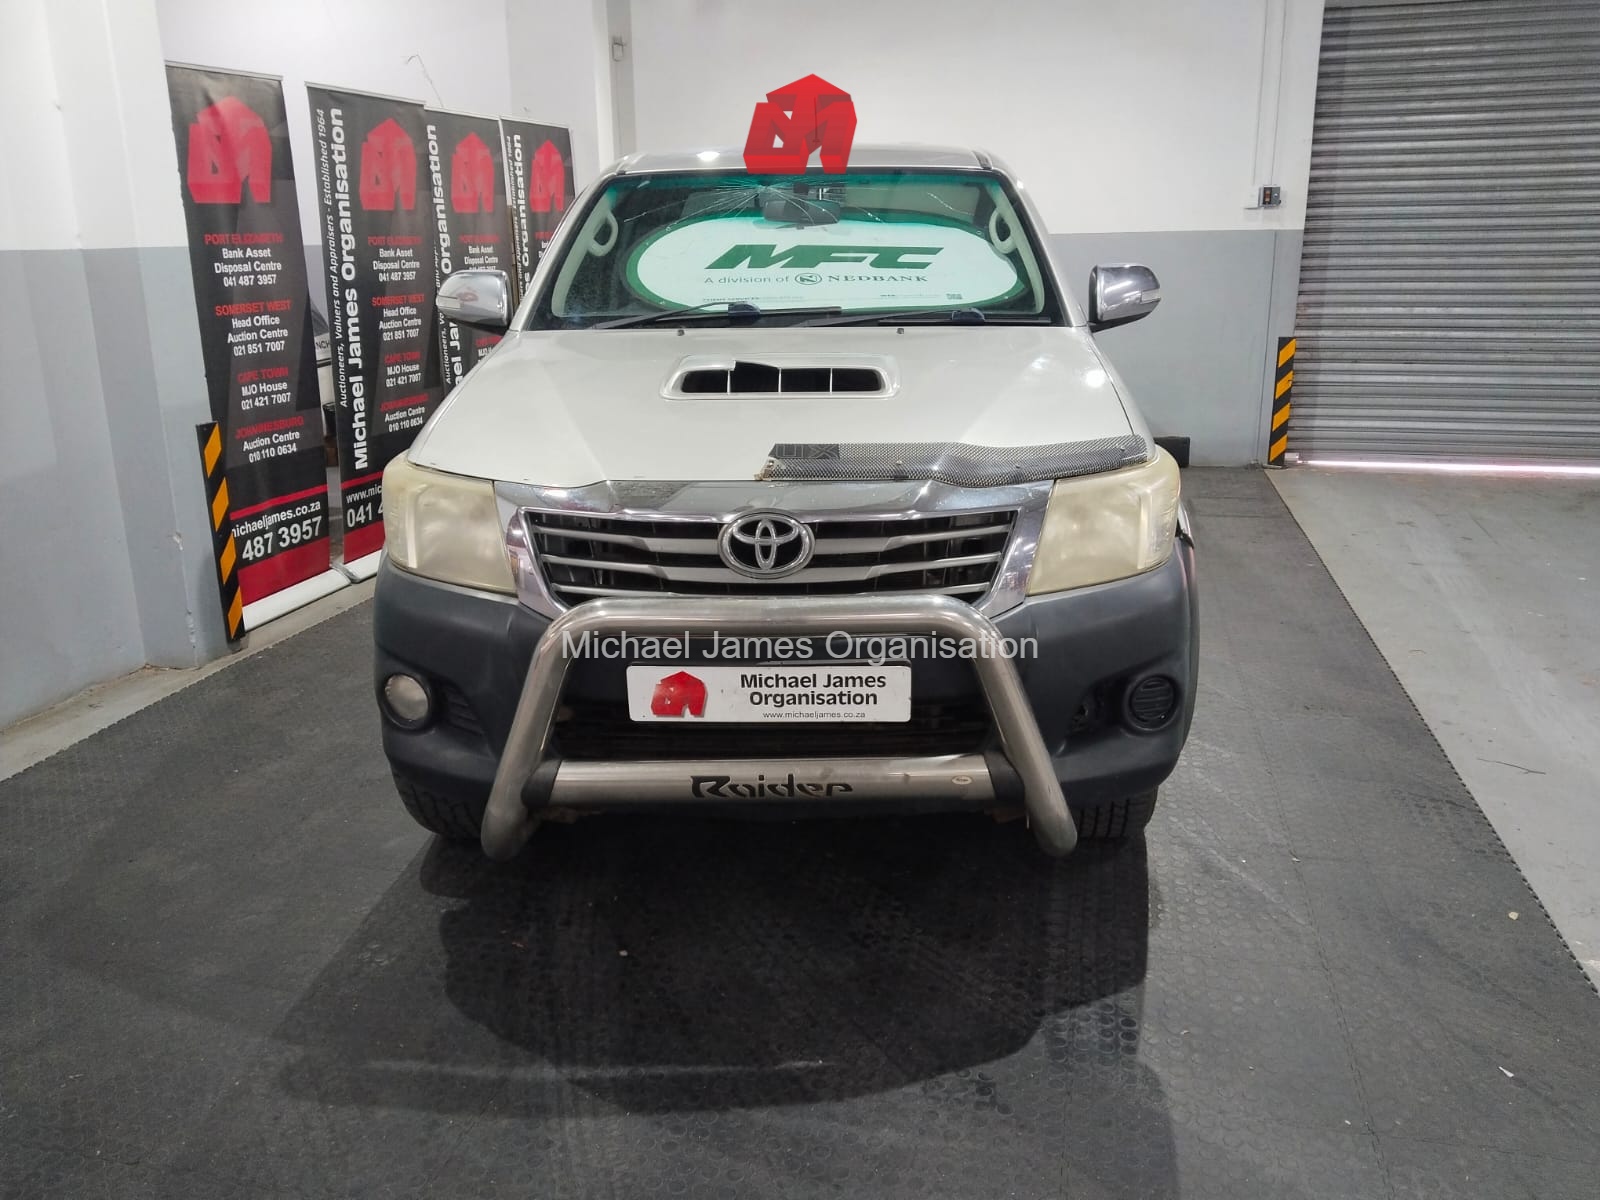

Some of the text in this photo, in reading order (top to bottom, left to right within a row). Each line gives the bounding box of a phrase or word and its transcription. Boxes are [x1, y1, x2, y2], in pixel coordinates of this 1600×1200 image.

[316, 108, 326, 137] 1964
[318, 140, 332, 205] Established
[427, 124, 452, 274] Organisation
[514, 134, 529, 266] Organisation
[205, 234, 229, 245] PORT
[327, 214, 338, 274] Appraisers
[222, 247, 271, 259] Bank Asset
[379, 248, 413, 257] Bank Asset
[704, 244, 944, 270] MFC
[214, 261, 282, 275] Disposal Centre
[373, 260, 420, 271] Disposal Centre
[223, 274, 277, 287] 041 487 3957
[330, 275, 339, 296] and
[379, 273, 389, 282] 041
[718, 275, 771, 284] division
[775, 275, 790, 283] of
[330, 108, 368, 470] Michael James Organisation
[215, 300, 291, 316] SOMERSET WEST
[383, 306, 416, 317] Head Office
[232, 315, 280, 328] Head Office
[334, 300, 342, 340] Valuers
[379, 318, 421, 330] Auction Centre
[227, 328, 288, 343] Auction Centre
[234, 341, 285, 356] 021 851 7007
[338, 343, 348, 408] Auctioneers,
[387, 364, 419, 376] MJO House
[242, 382, 288, 396] MJO House
[241, 393, 291, 410] 021 421 7007
[385, 406, 425, 422] Auction Centre
[243, 431, 300, 451] Auction Centre
[262, 448, 275, 459] 110
[277, 443, 297, 456] 0634
[347, 503, 372, 528] 041
[242, 516, 322, 560] 487 3957
[740, 674, 886, 688] Michael James
[750, 690, 878, 708] Organisation
[762, 711, 866, 719] www.michaeljames.co.za
[690, 774, 853, 798] Raider
